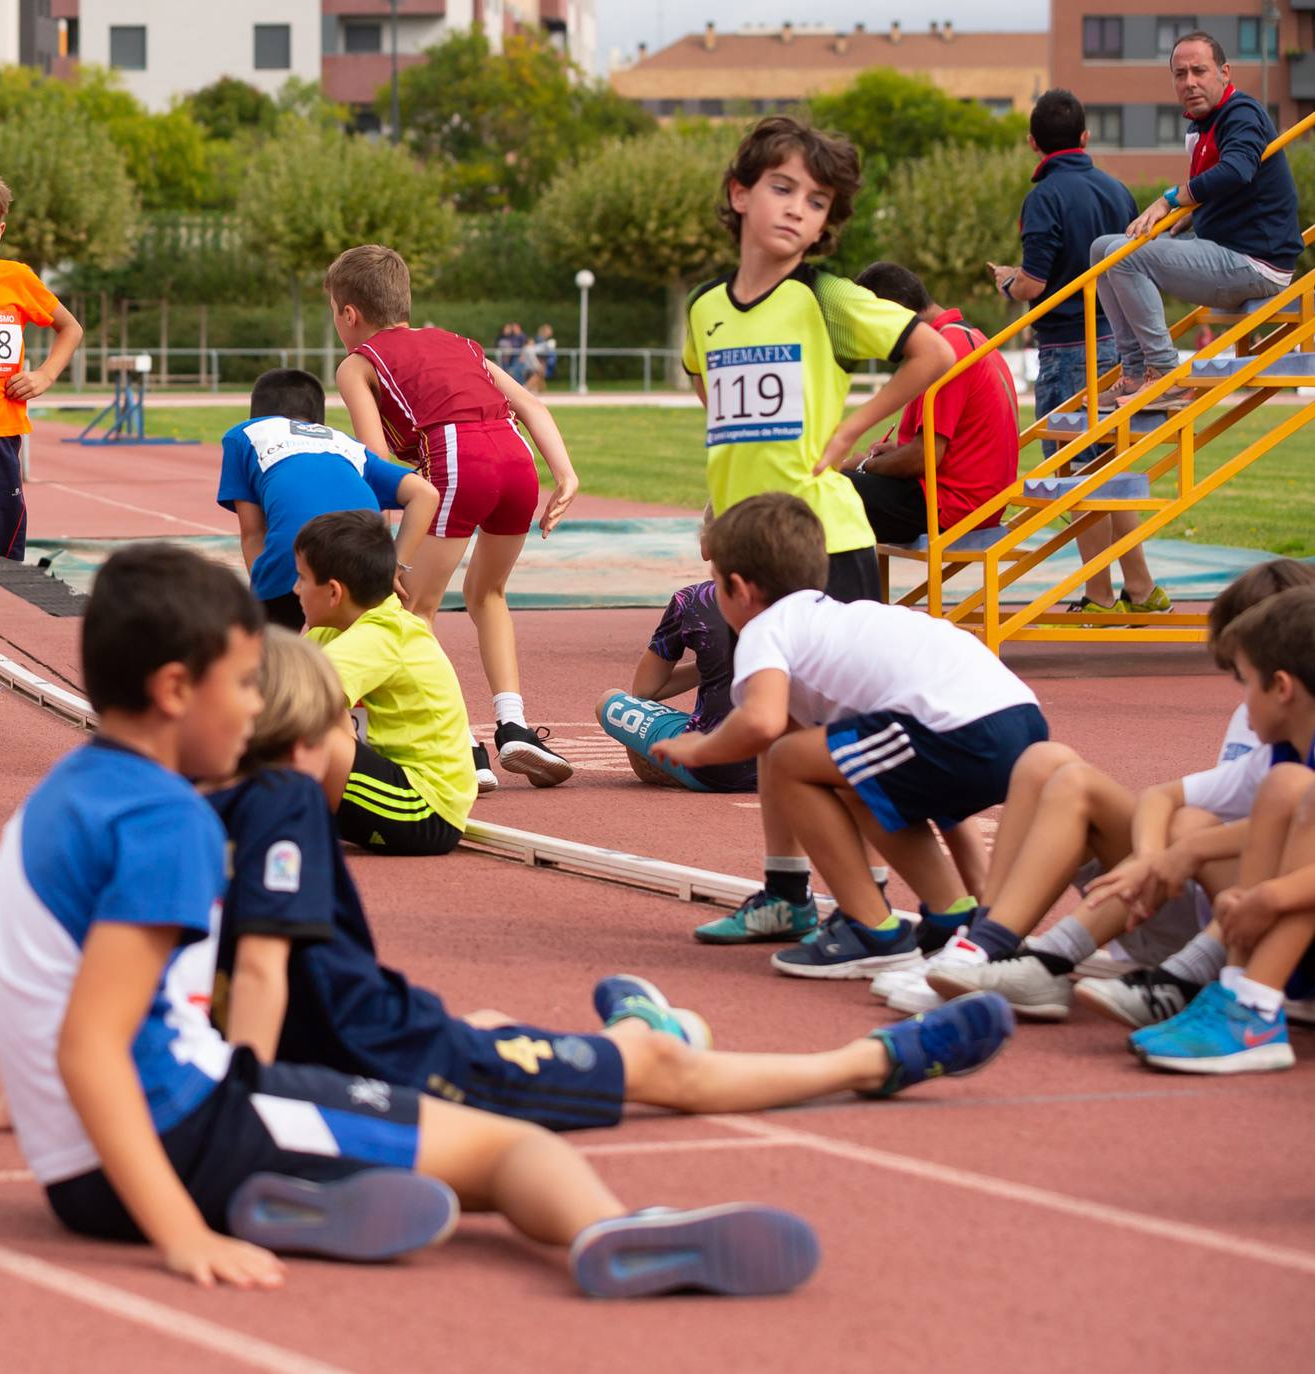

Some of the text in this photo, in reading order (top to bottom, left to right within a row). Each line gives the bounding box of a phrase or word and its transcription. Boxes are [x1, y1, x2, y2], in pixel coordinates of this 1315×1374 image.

[721, 345, 793, 366] HEMAFIX
[713, 373, 784, 421] 119
[638, 716, 655, 740] STOP
